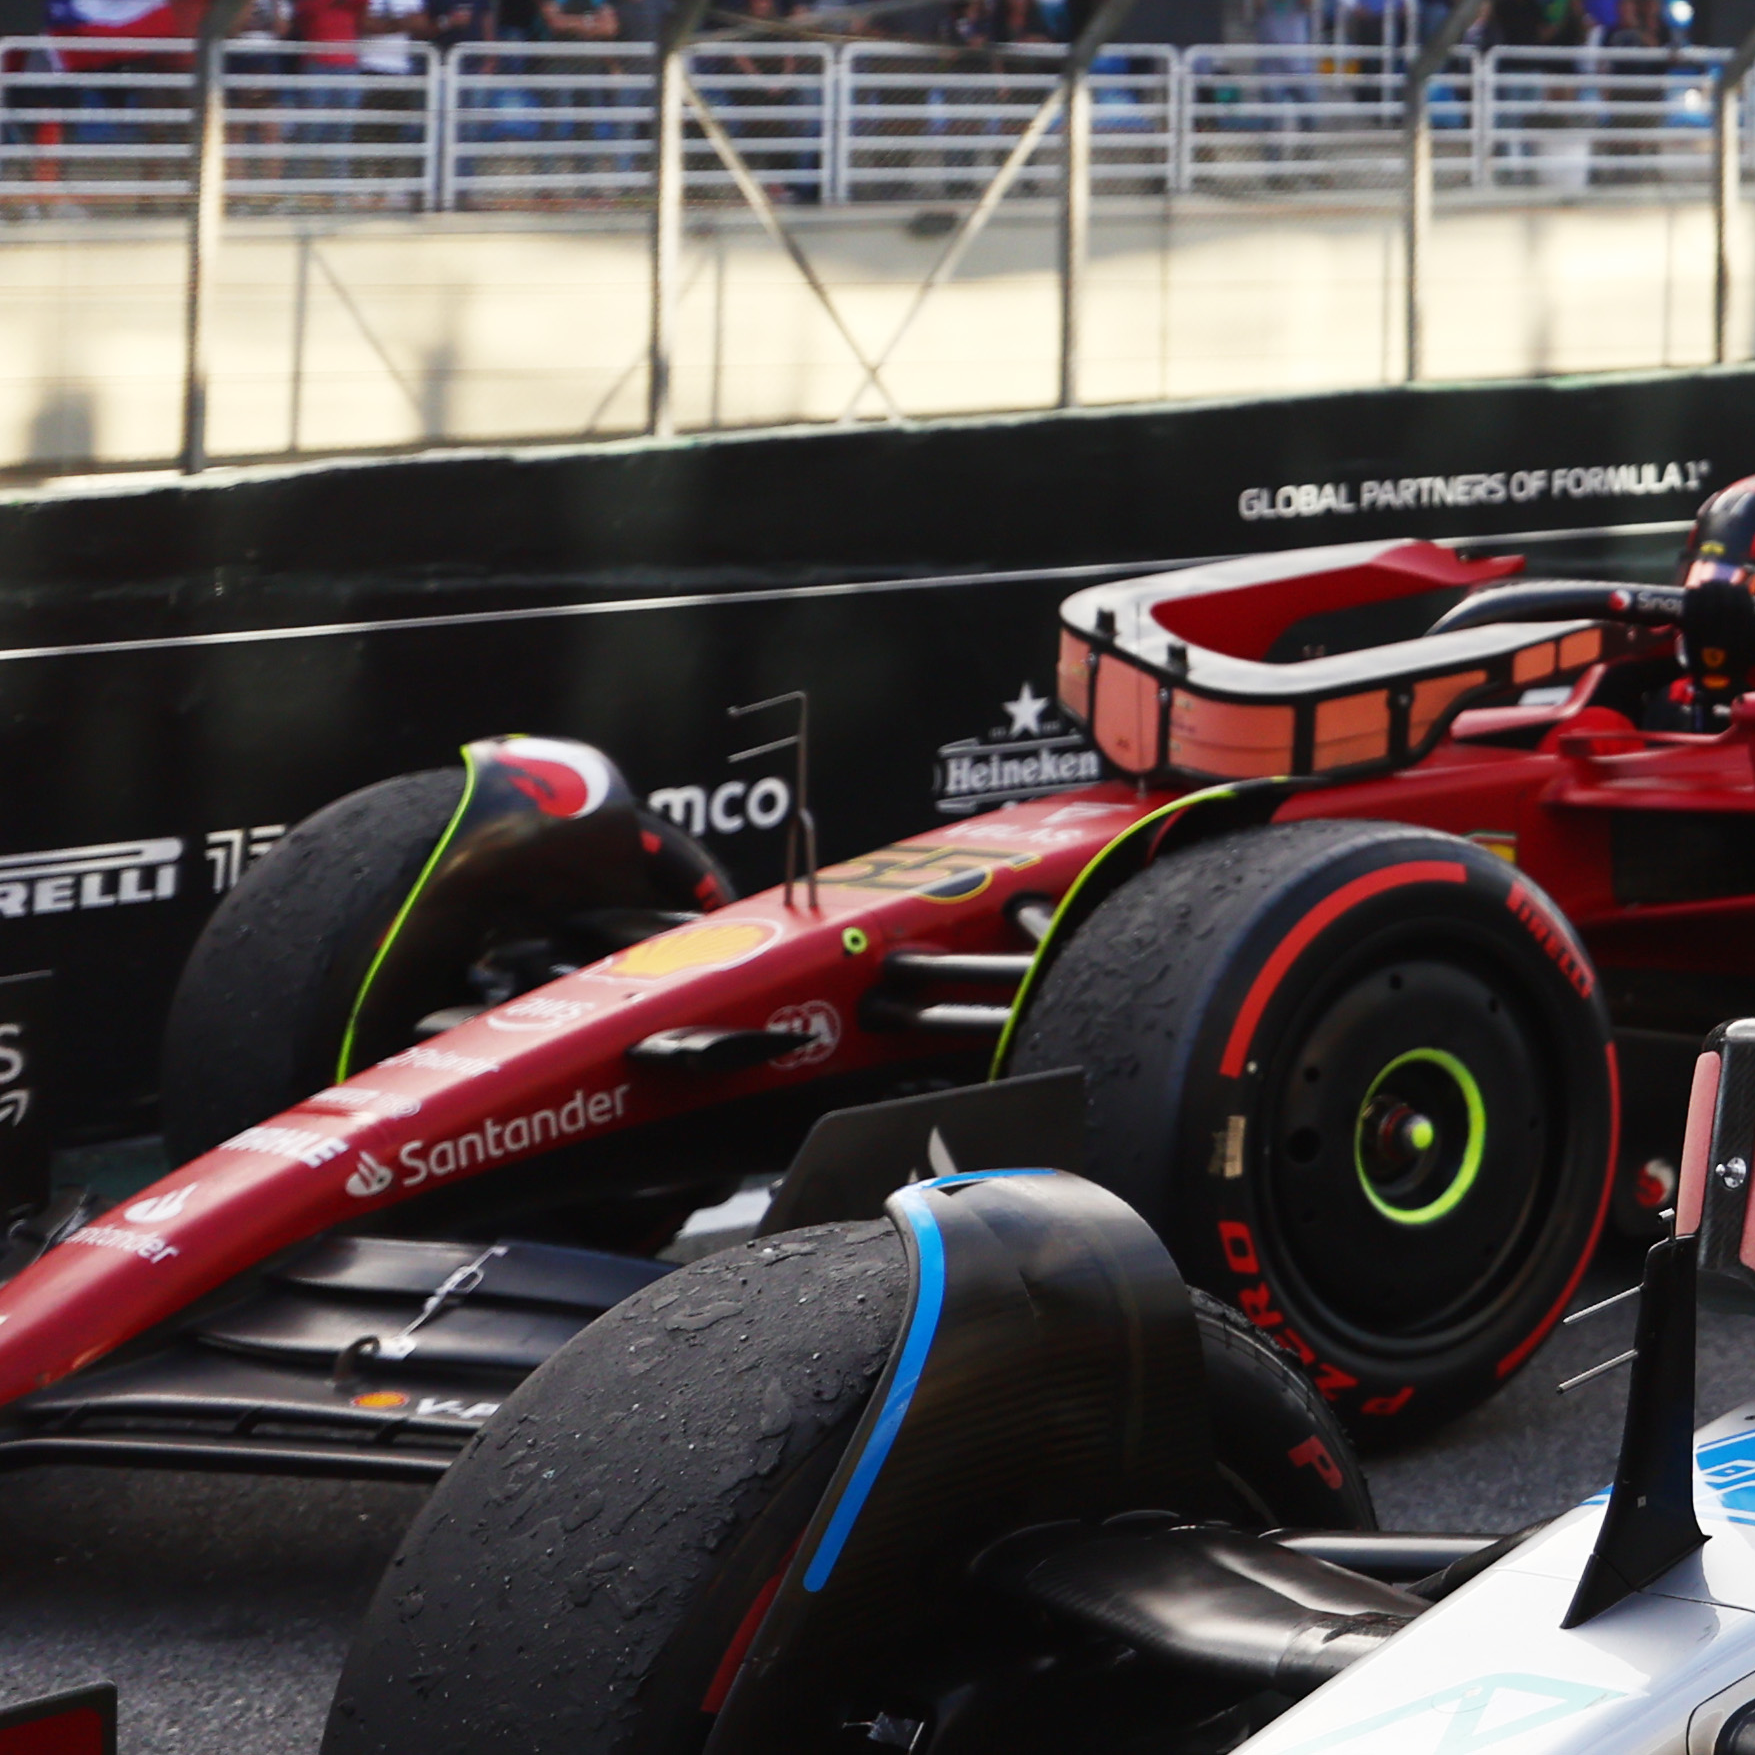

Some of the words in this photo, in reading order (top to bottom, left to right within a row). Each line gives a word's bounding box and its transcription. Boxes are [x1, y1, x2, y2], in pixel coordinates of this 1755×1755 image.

[1239, 483, 1356, 521] GLOBAL
[1361, 472, 1508, 510] PARTNERS
[1510, 466, 1550, 502] OF
[1551, 460, 1684, 498] FORMULA
[946, 746, 1101, 796] Heineken
[1505, 879, 1598, 1000] PIRELLI
[402, 1083, 631, 1187] Santander
